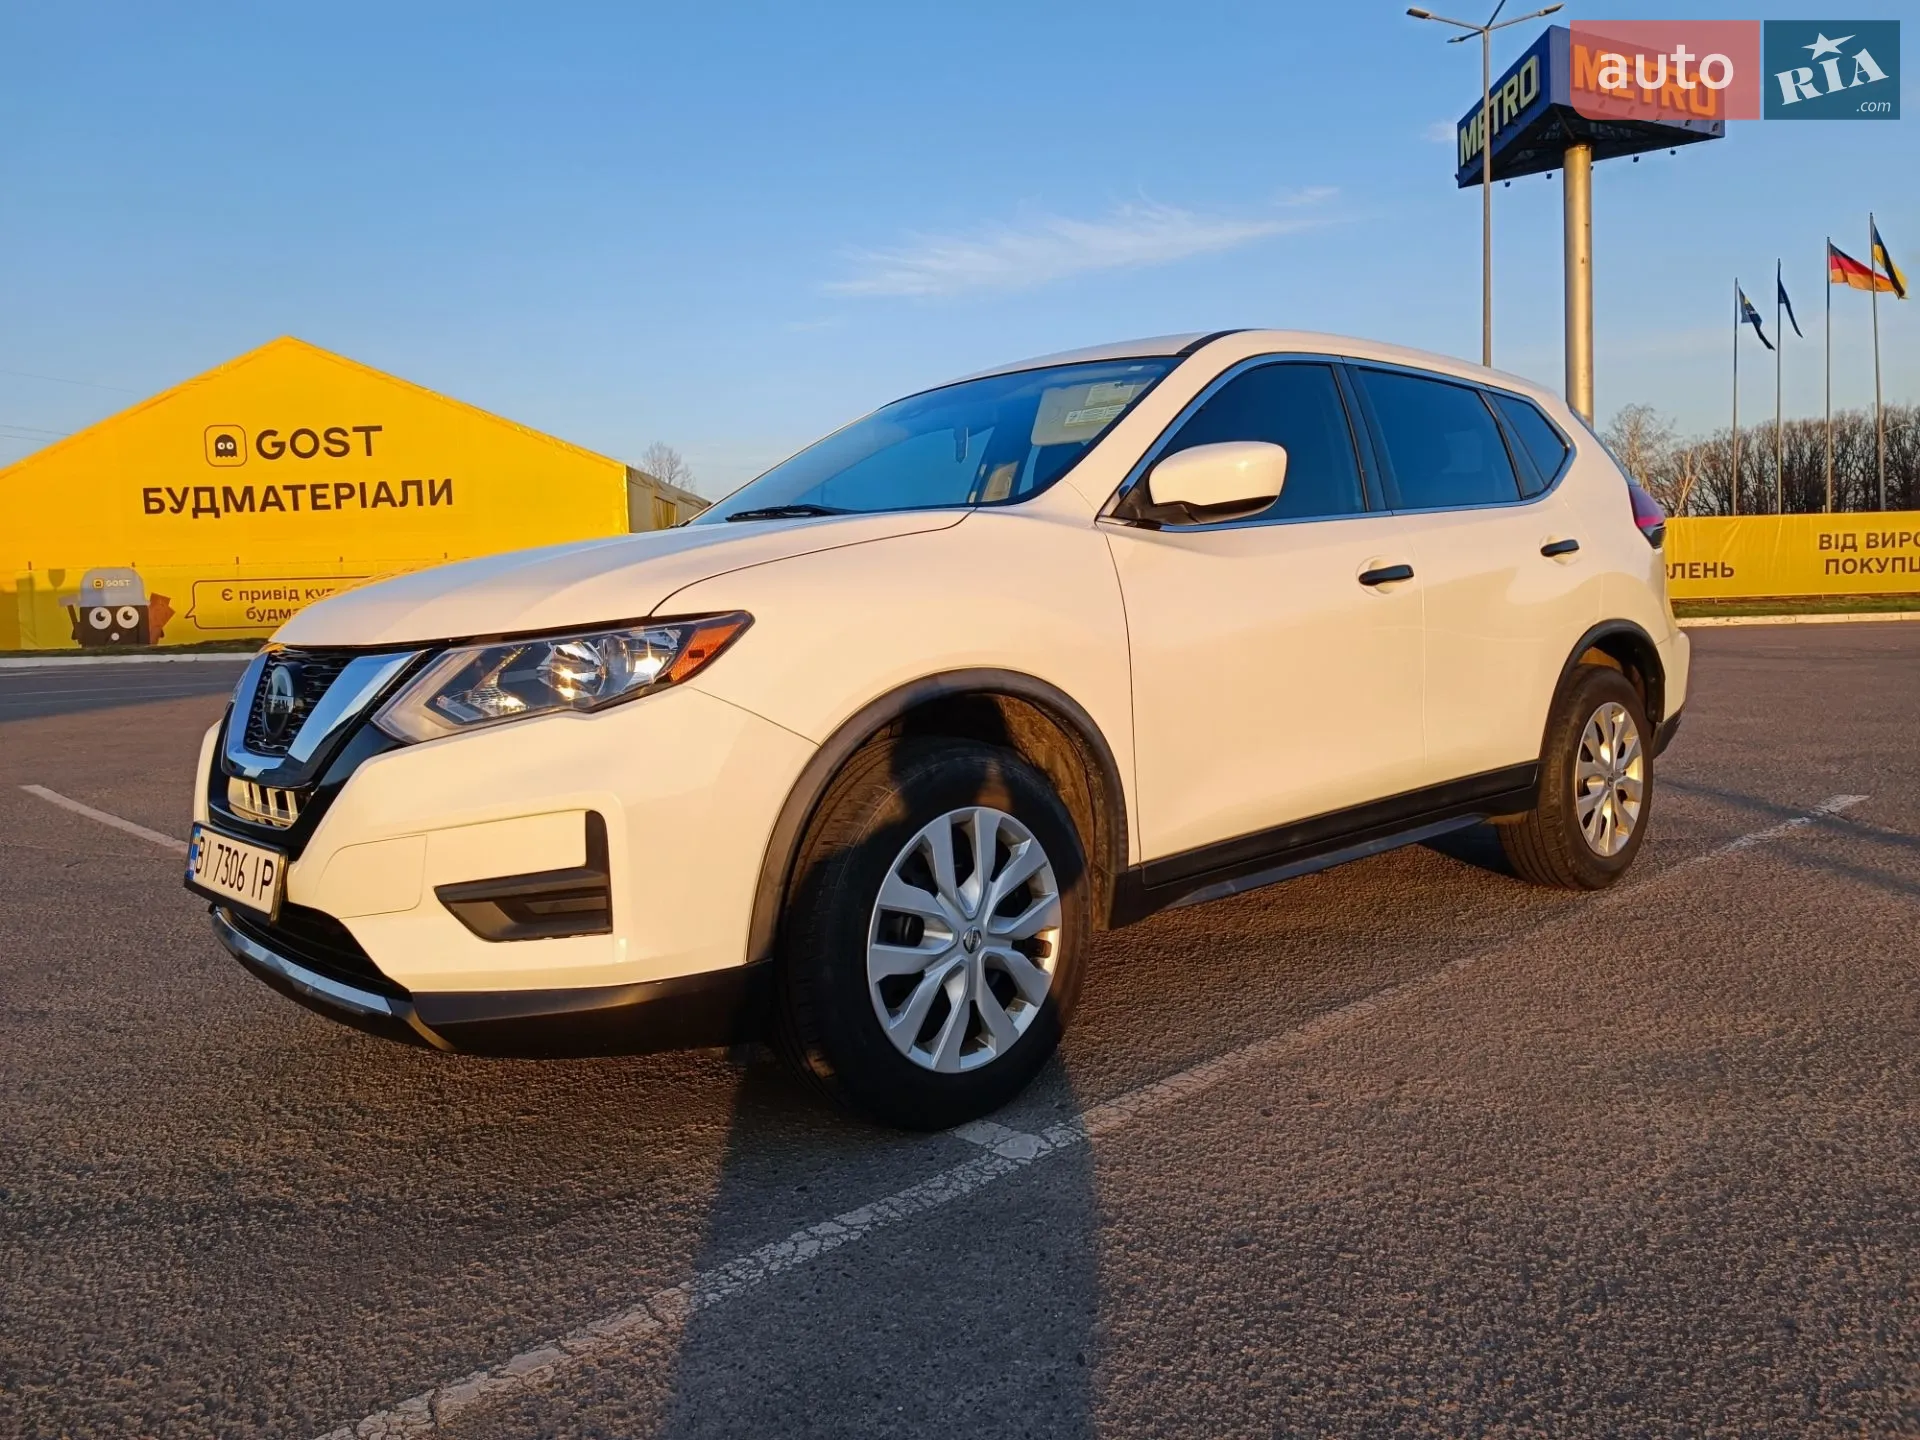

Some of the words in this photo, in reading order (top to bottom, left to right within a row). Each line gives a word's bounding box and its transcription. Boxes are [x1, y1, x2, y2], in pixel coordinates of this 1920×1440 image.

[256, 425, 382, 460] GOST
[143, 478, 453, 519] БУДМАТЕРІАЛИ
[1818, 533, 1858, 552] ВІД
[1665, 562, 1735, 579] ЛЕНЬ
[239, 586, 299, 603] привід
[213, 843, 248, 892] 7306
